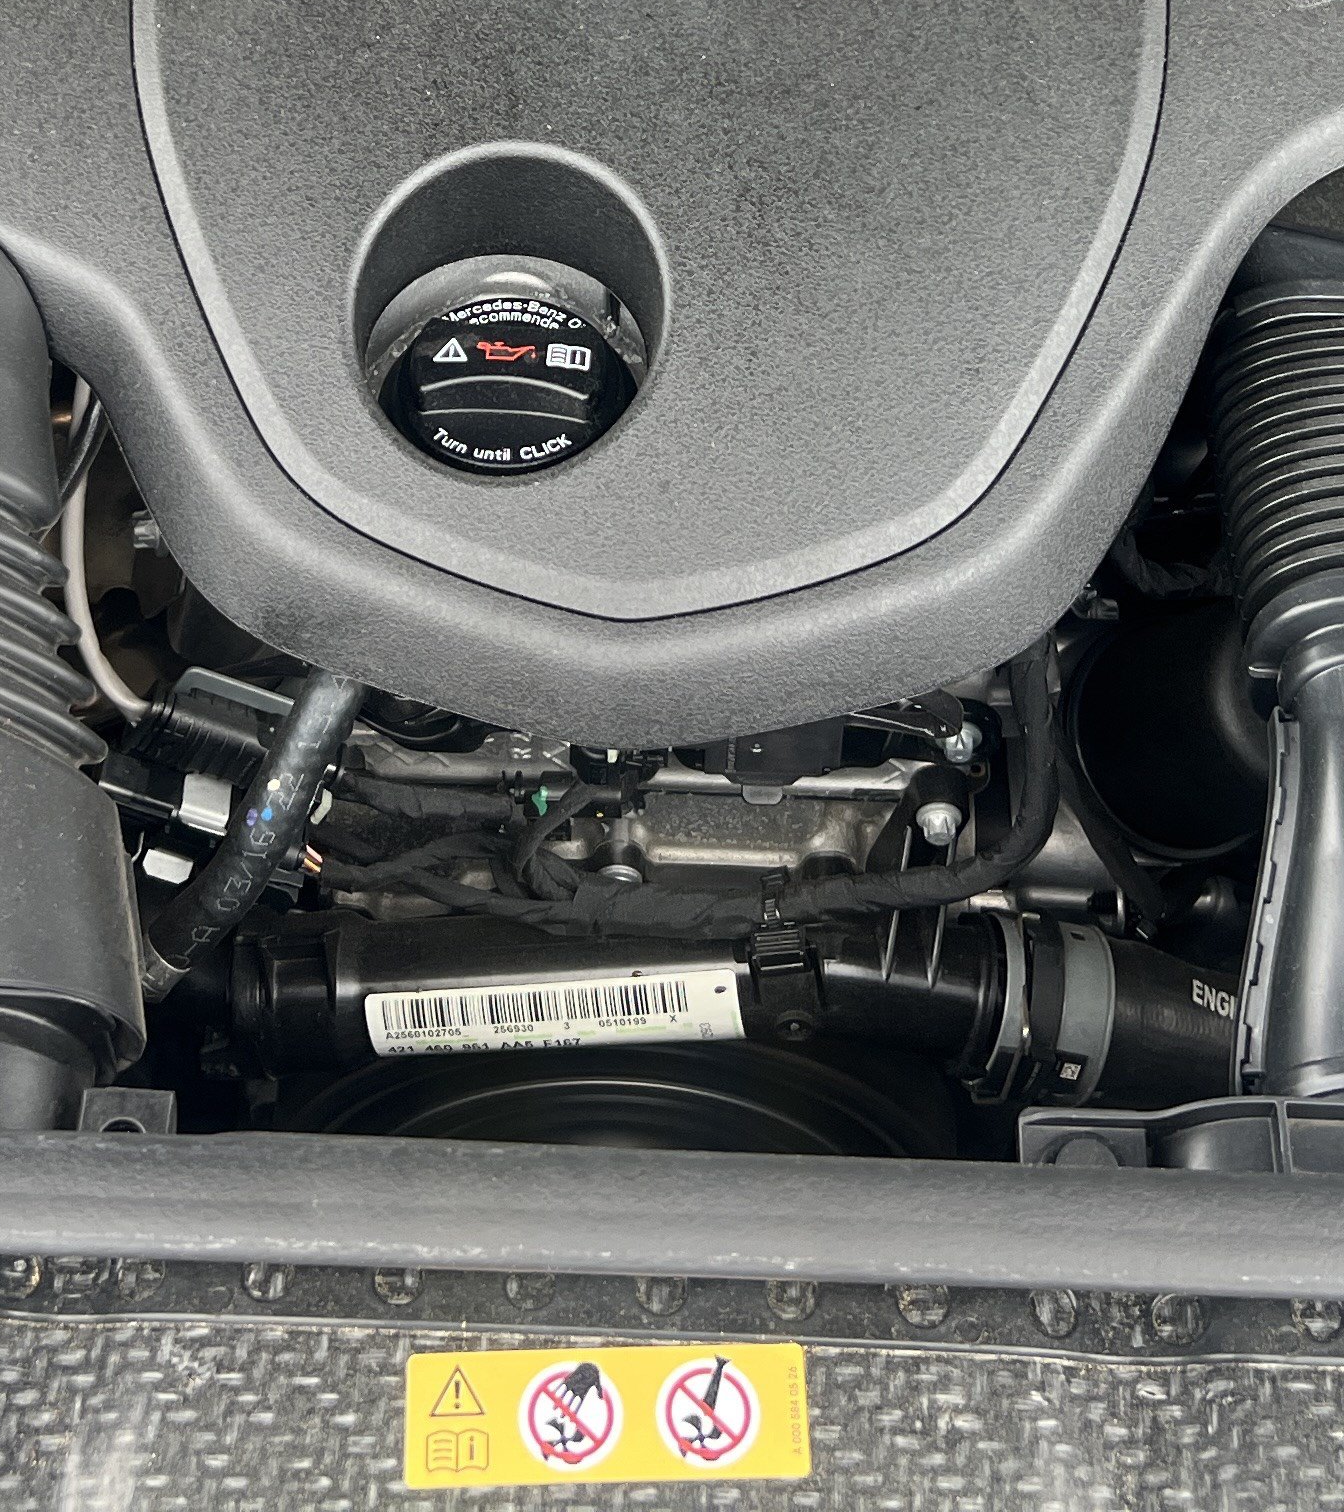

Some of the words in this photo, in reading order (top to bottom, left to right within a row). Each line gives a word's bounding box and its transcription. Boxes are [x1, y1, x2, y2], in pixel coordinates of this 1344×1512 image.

[433, 427, 468, 454] Turn
[473, 447, 511, 461] until
[519, 433, 572, 460] CLICK
[563, 1021, 571, 1030] 3
[669, 1009, 678, 1023] X
